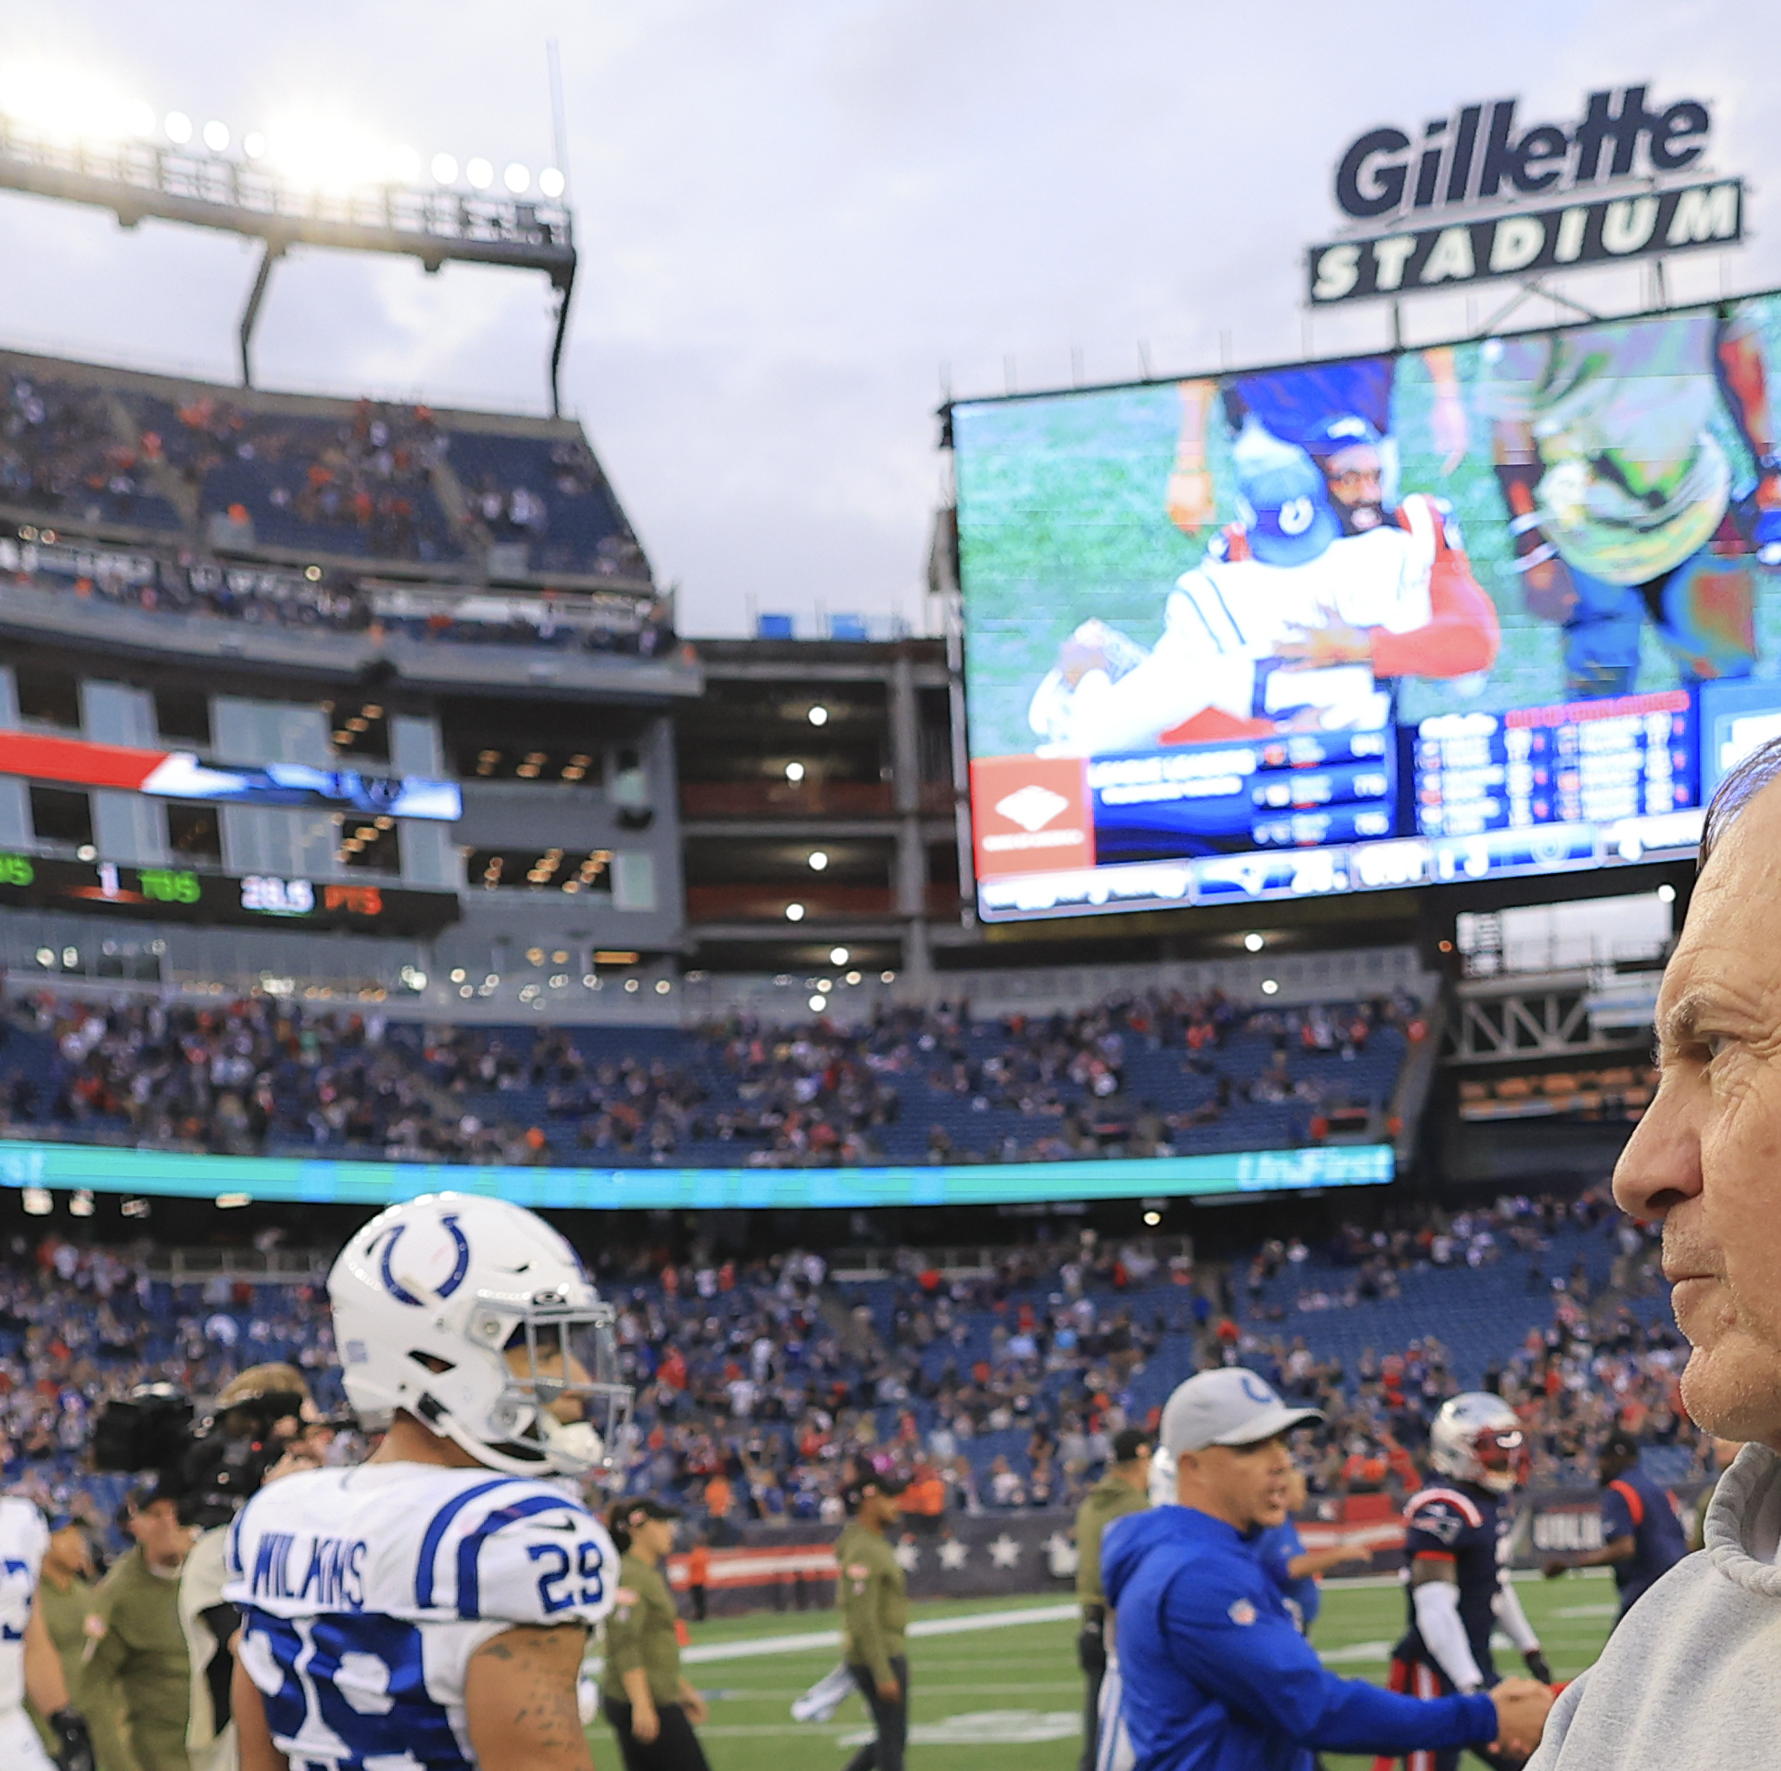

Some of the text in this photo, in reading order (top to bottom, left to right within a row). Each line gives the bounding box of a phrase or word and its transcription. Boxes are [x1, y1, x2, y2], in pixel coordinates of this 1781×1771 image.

[1336, 85, 1710, 218] Gillette
[1312, 185, 1738, 300] STADIUM
[526, 1540, 604, 1614] 29
